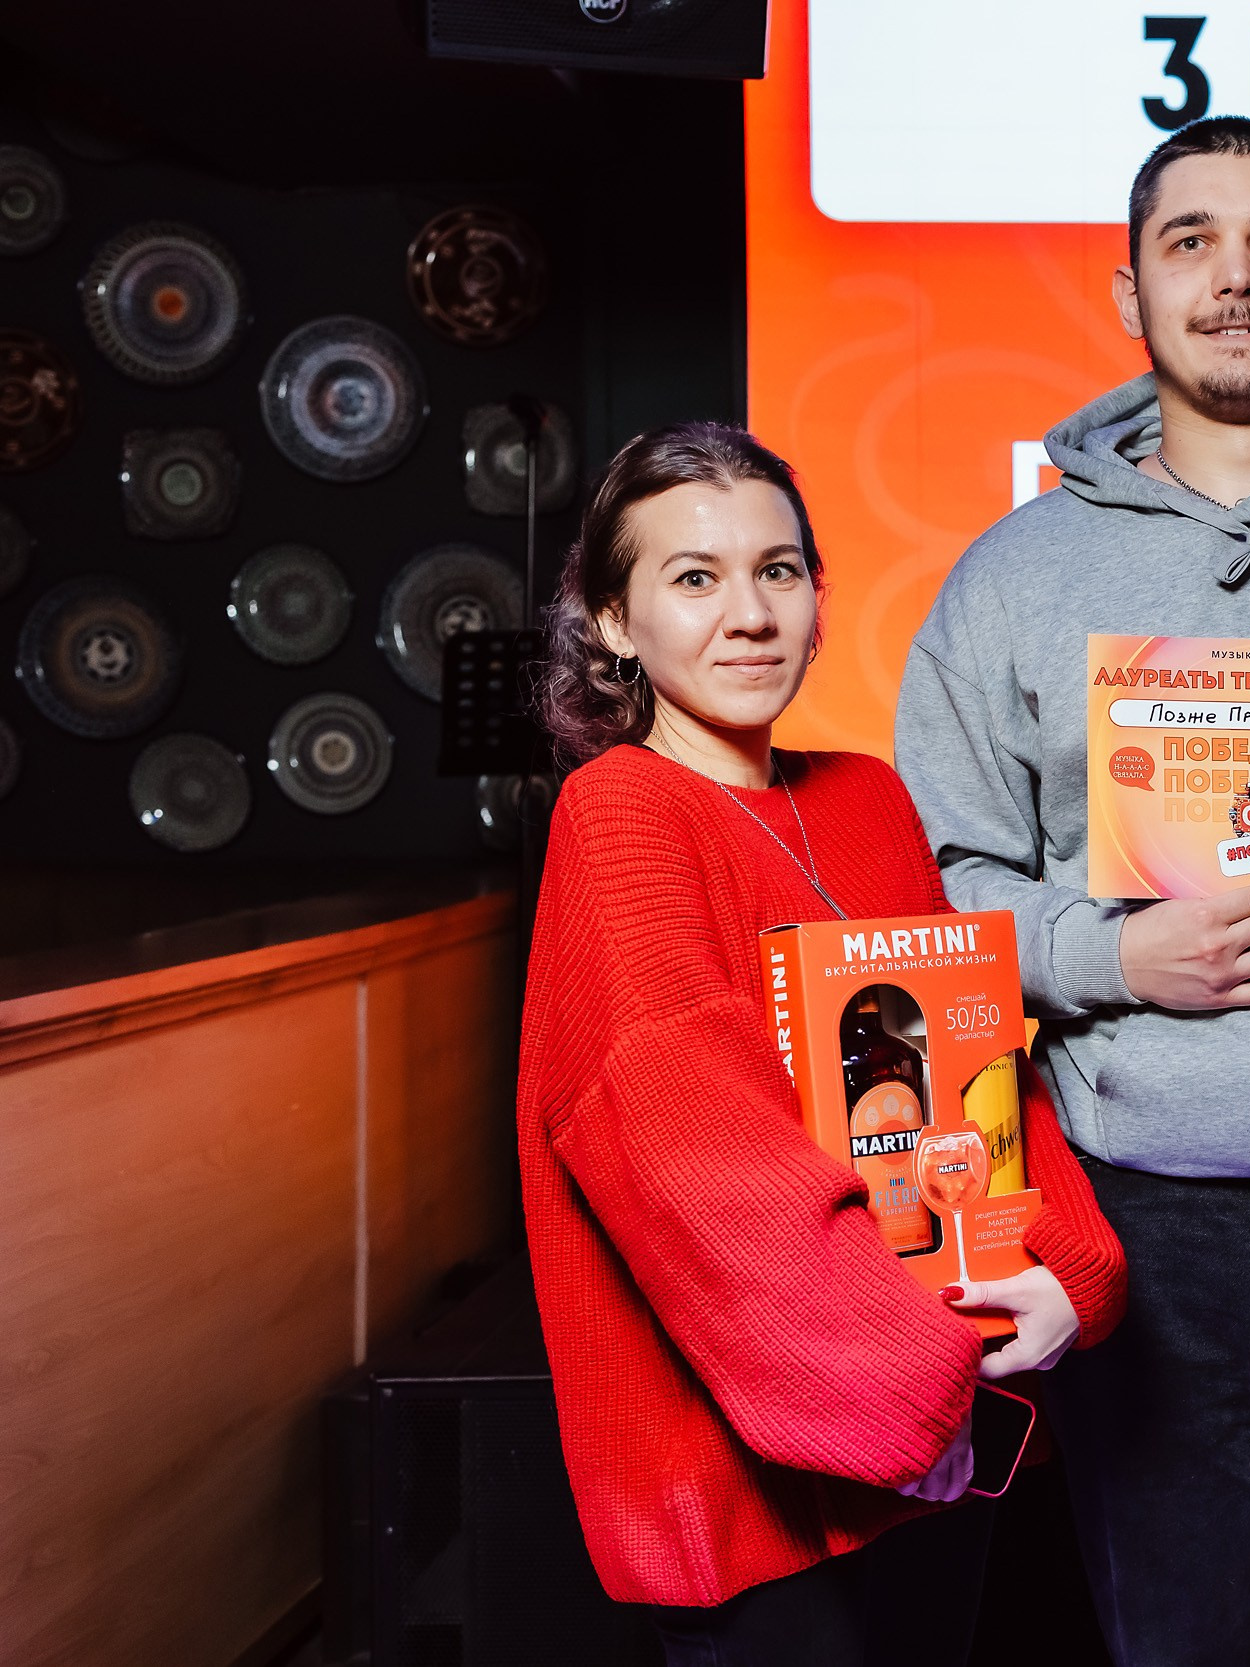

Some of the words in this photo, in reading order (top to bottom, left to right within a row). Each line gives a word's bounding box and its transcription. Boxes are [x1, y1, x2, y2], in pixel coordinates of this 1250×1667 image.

[1141, 15, 1212, 131] 3
[1094, 666, 1225, 690] ЛАУРЕАТЫ
[1149, 703, 1217, 724] Позже
[1115, 755, 1145, 763] МУЗЫКА
[825, 965, 857, 977] ВКУС
[860, 956, 953, 974] ИТАЛЬЯНСКОЙ
[955, 953, 997, 965] ЖИЗНИ
[956, 993, 987, 1003] смешай
[771, 952, 795, 1088] ARTINI
[946, 1004, 1000, 1031] 50/50
[852, 1131, 921, 1156] MARTIN
[938, 1163, 968, 1174] MARTINI
[875, 1186, 919, 1208] FIERO
[988, 1216, 1018, 1228] MARTINI
[976, 1230, 998, 1240] FIERO
